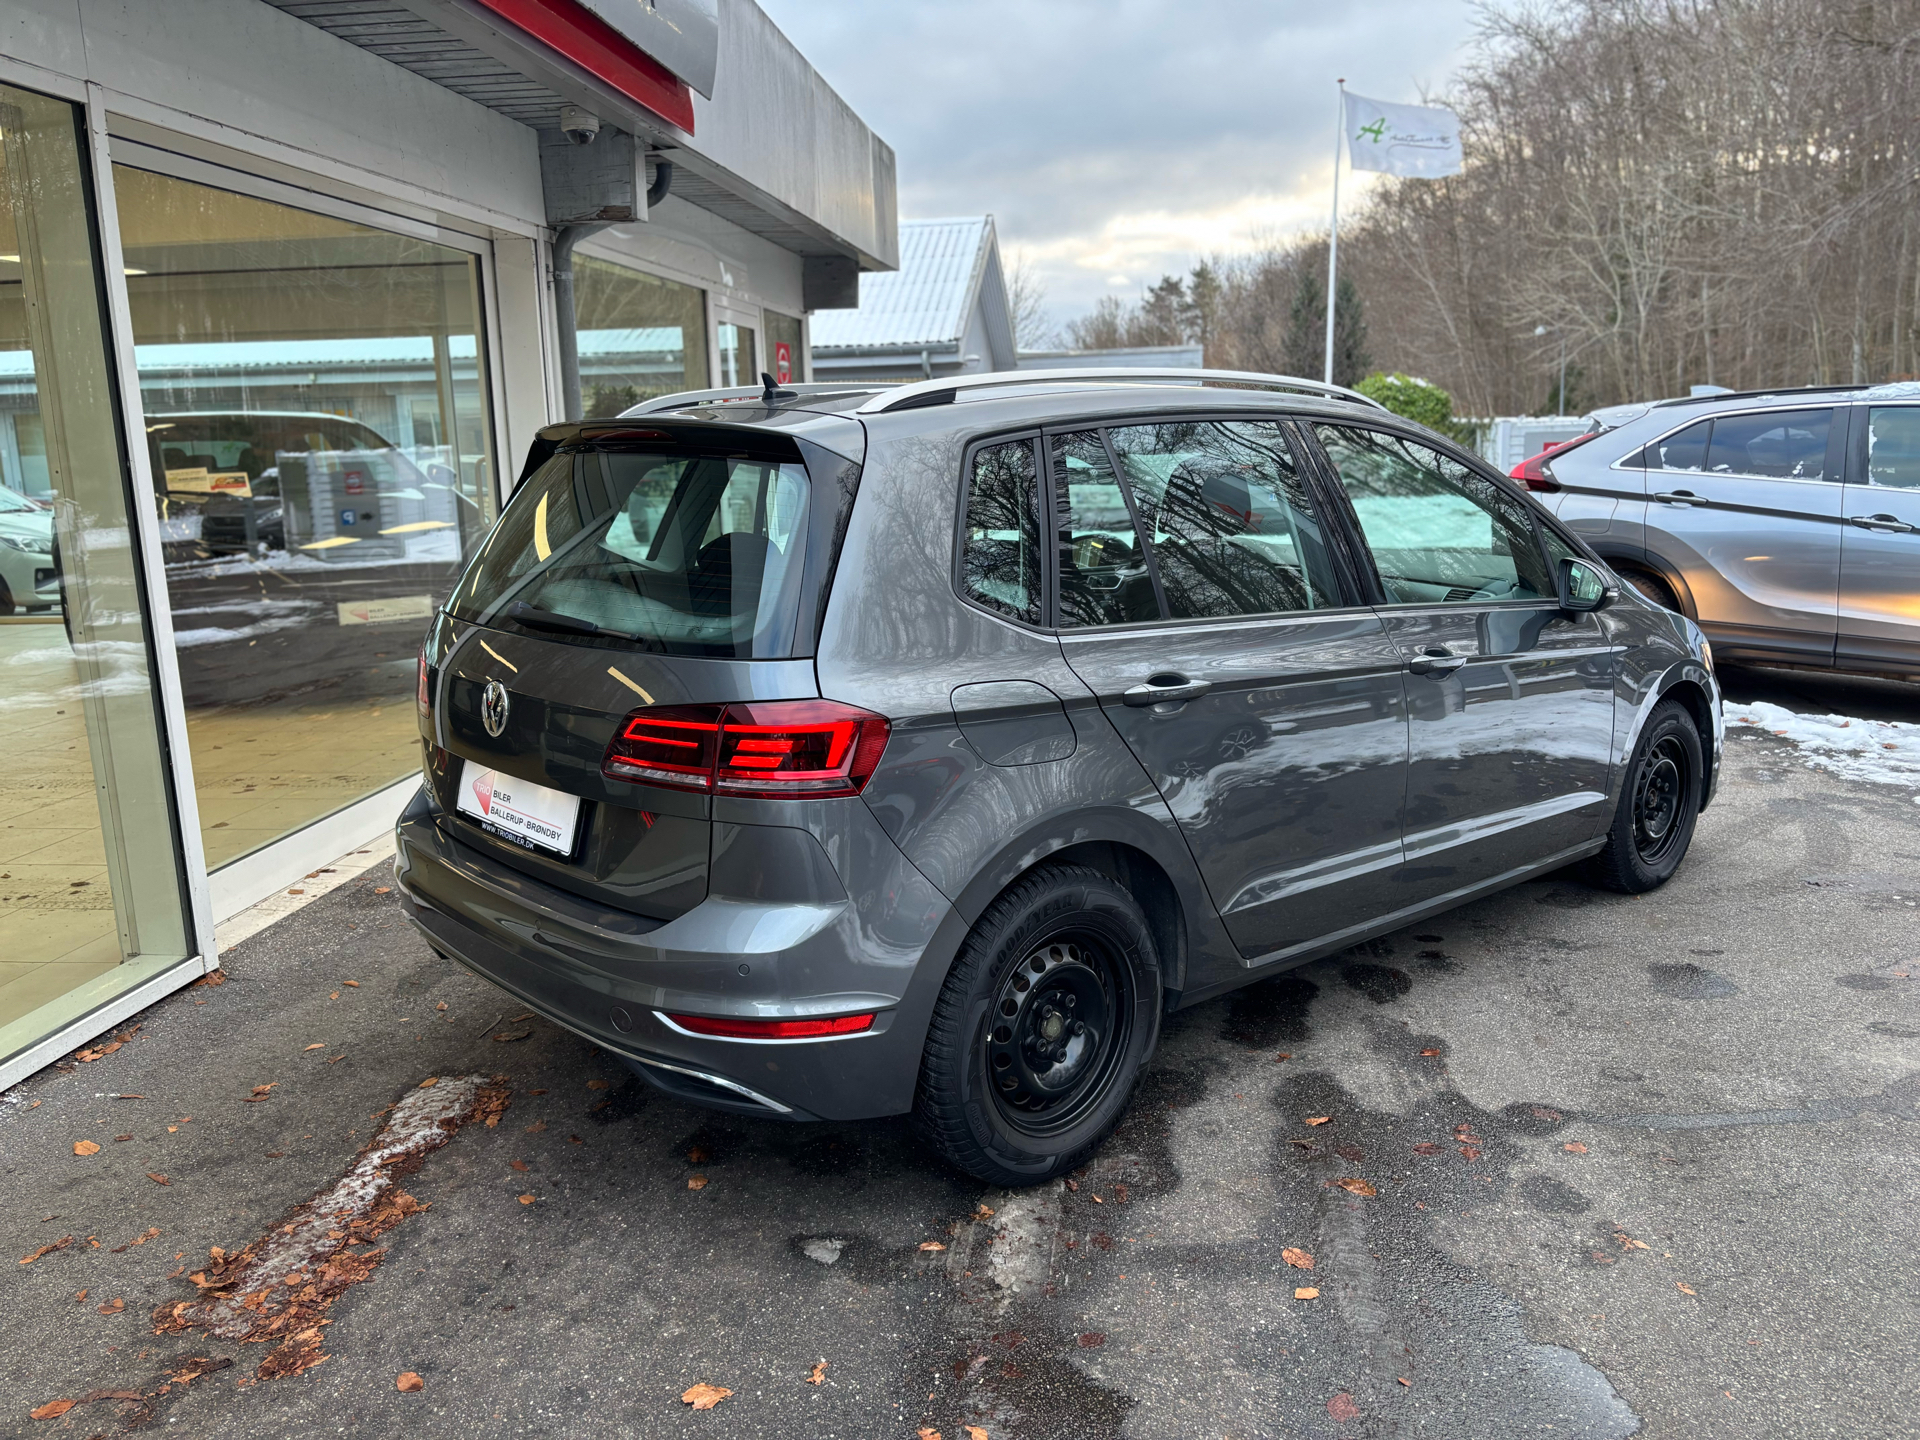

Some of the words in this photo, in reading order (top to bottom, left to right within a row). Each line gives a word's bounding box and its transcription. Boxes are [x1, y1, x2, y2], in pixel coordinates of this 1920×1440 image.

[476, 782, 491, 796] TRIO
[492, 789, 512, 804] BILER
[481, 821, 535, 851] WWW.TRIOBILER.DK
[988, 894, 1073, 979] GOODYEAR
